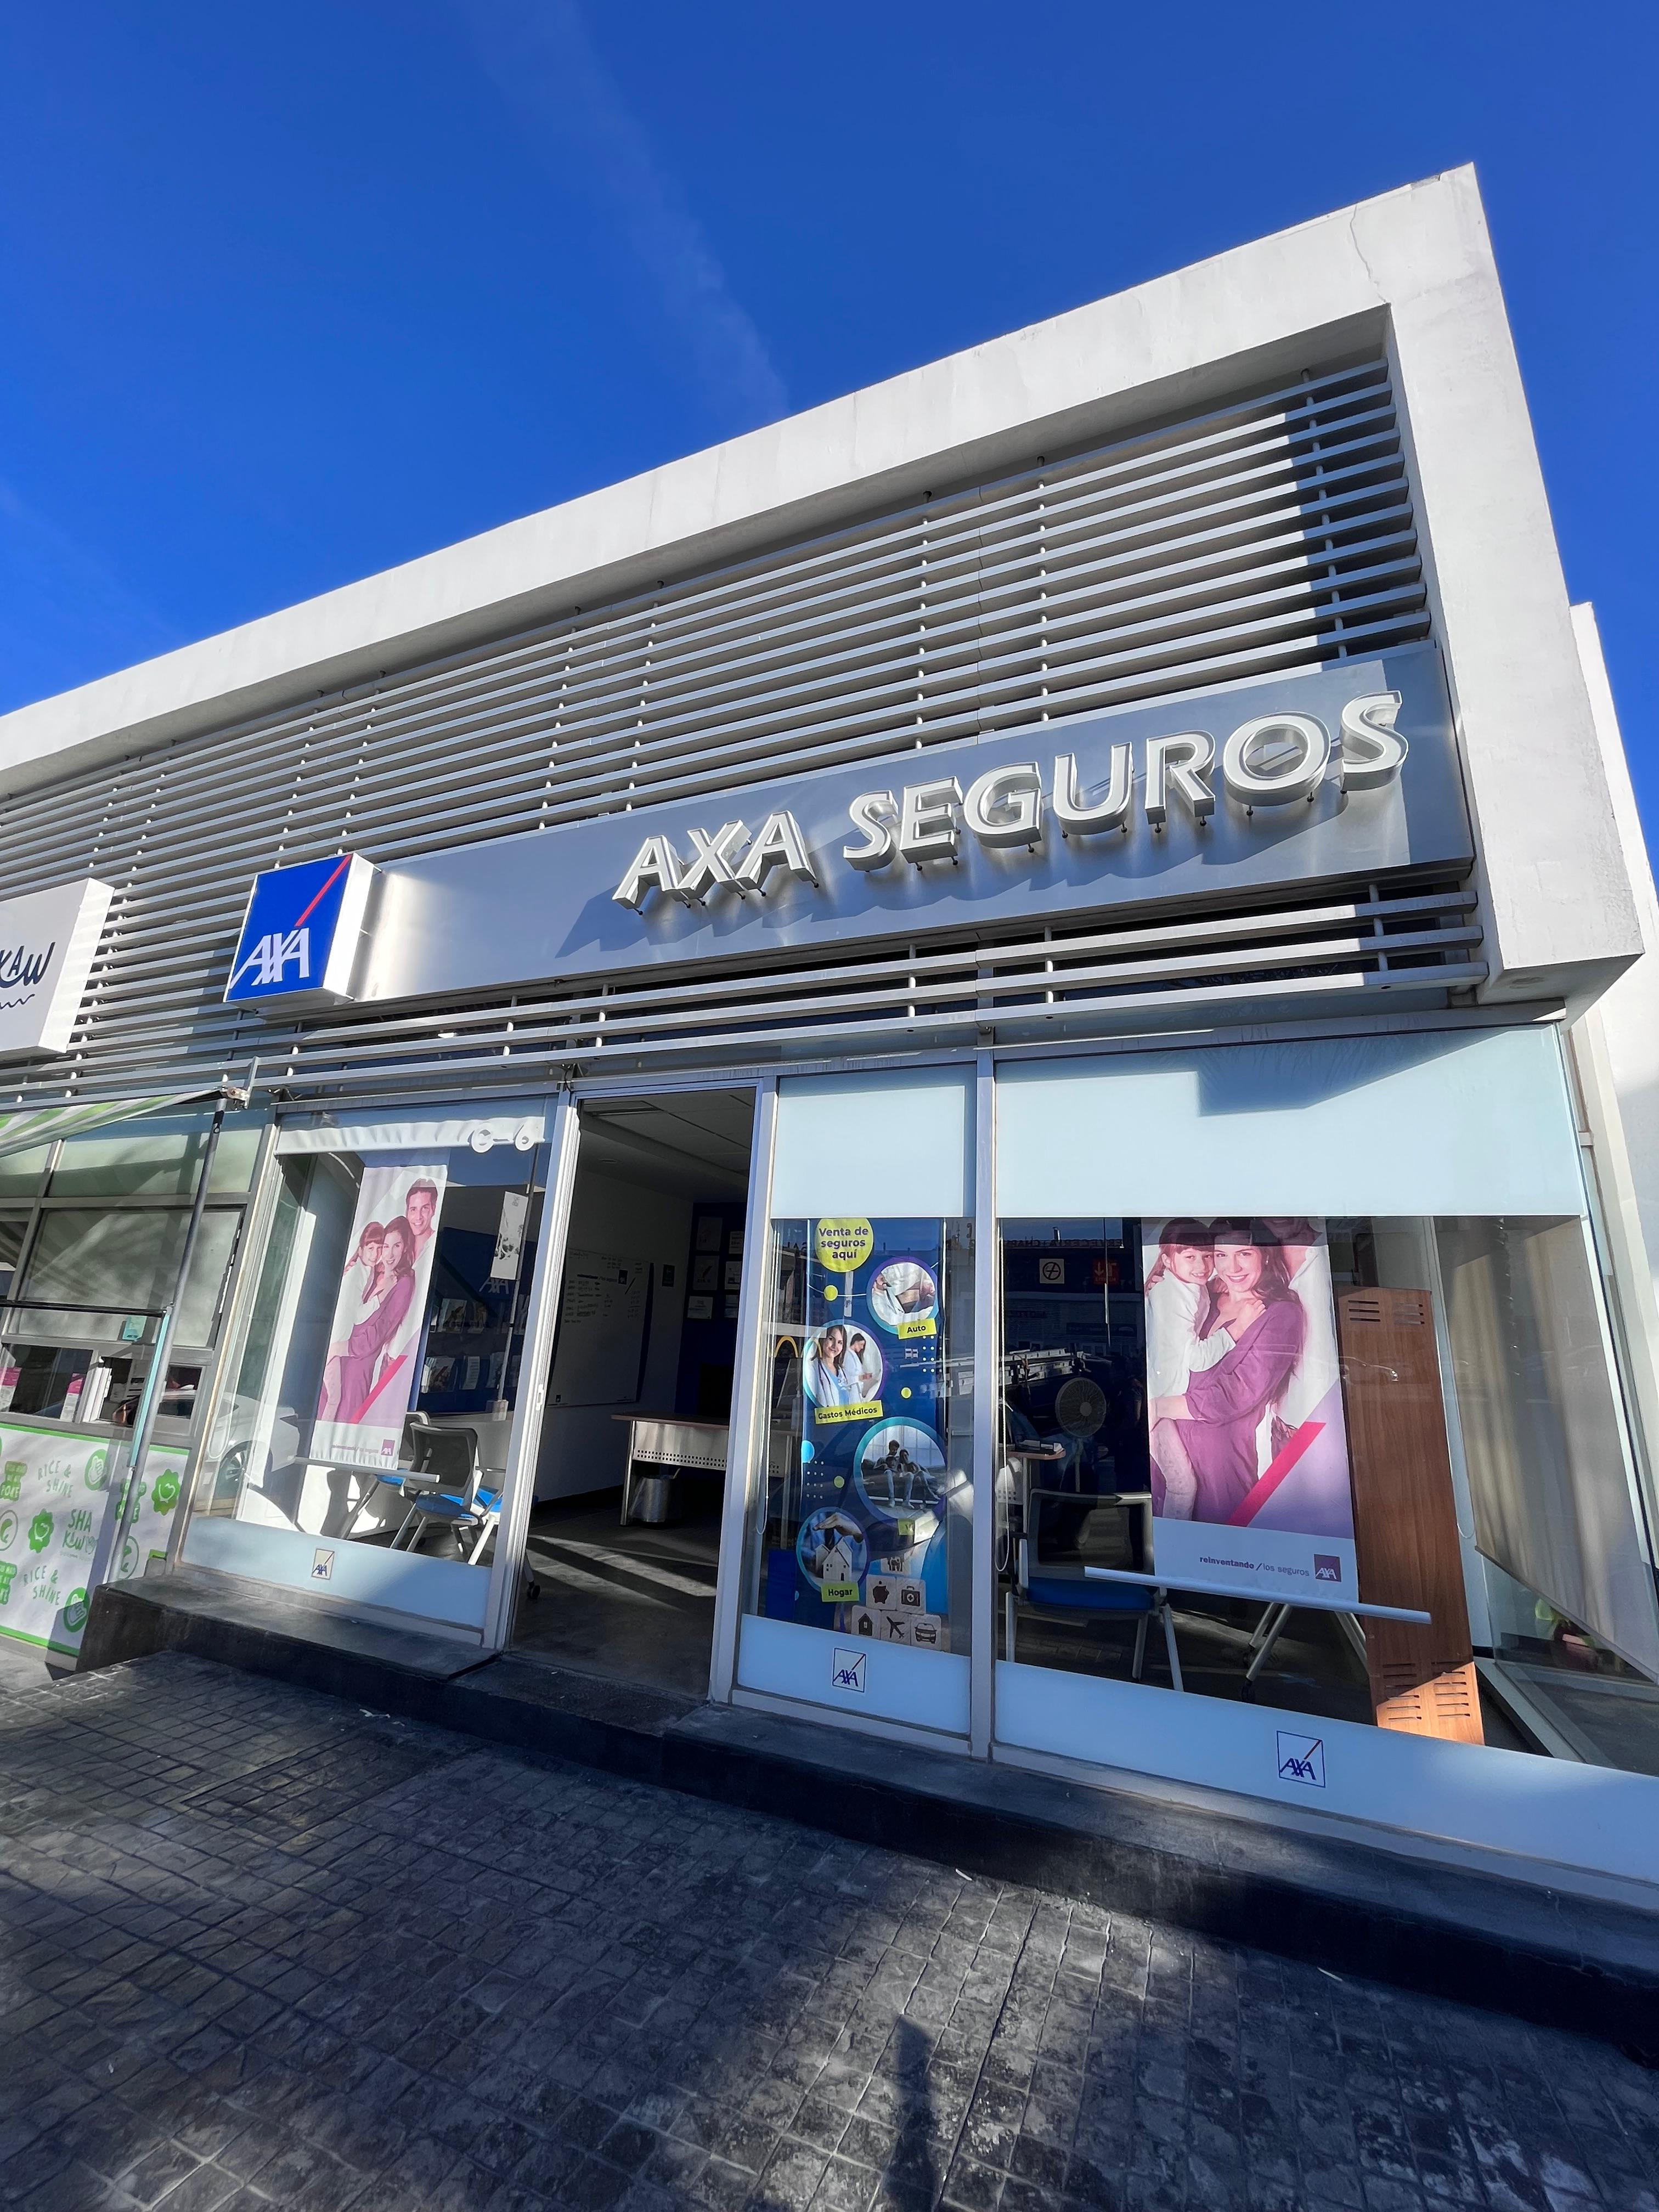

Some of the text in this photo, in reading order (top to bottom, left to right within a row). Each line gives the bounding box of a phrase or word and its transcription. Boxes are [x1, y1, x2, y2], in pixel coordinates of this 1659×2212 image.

[612, 690, 1410, 911] AXA SEGUROS
[229, 927, 309, 989] AXA
[819, 1226, 868, 1237] Venta de
[821, 1239, 866, 1249] seguros
[832, 1249, 857, 1261] aquí
[906, 1325, 926, 1334] Auto
[844, 1407, 878, 1416] Médicos
[38, 1460, 61, 1480] RICE
[46, 1477, 74, 1498] SHINE
[67, 1509, 93, 1532] SHA
[312, 1564, 328, 1577] AXA
[1199, 1556, 1254, 1569] reinventando
[1278, 1566, 1310, 1577] seguros
[1313, 1567, 1338, 1580] AXA
[32, 1584, 61, 1605] SHINE
[828, 1588, 853, 1598] Hogar
[833, 1669, 859, 1687] AXA
[1279, 1758, 1316, 1780] AXA
